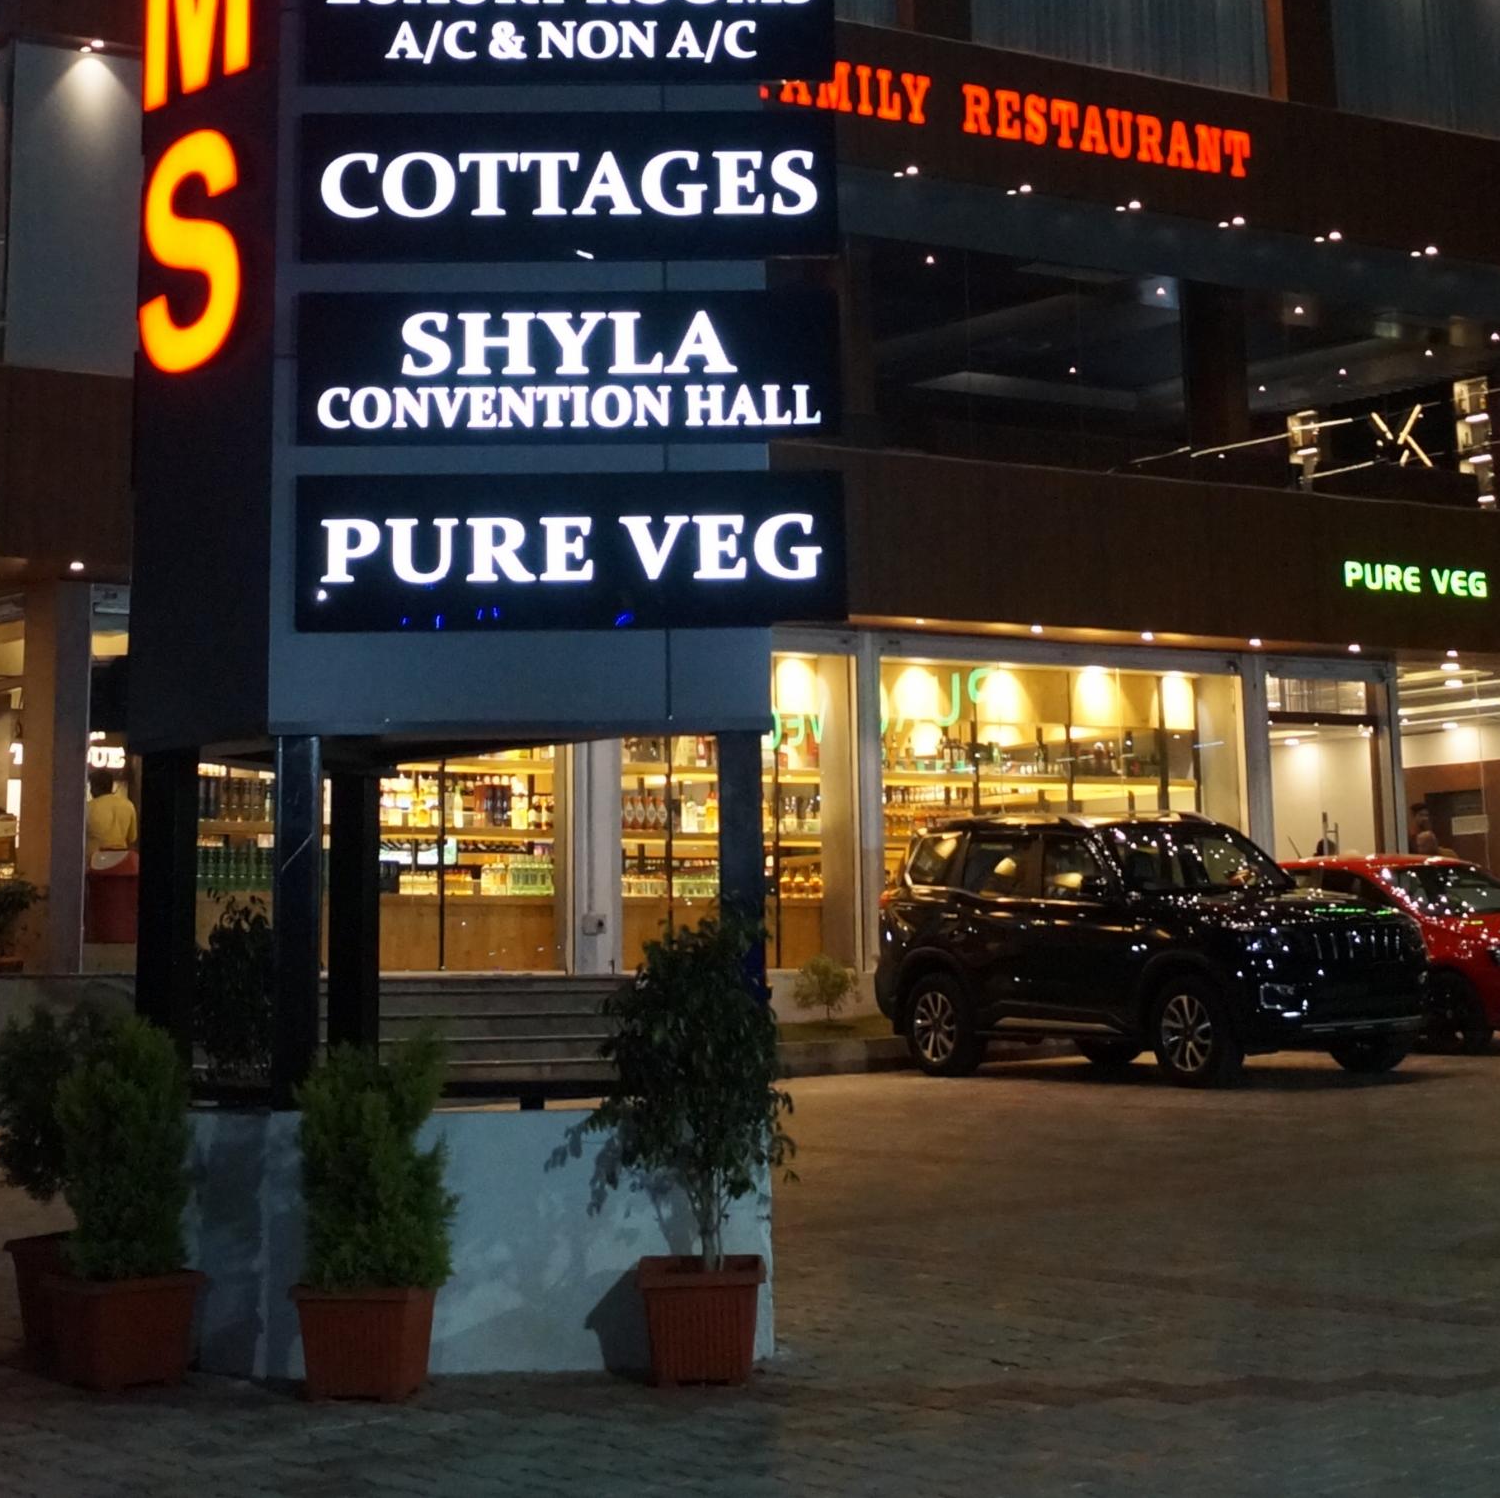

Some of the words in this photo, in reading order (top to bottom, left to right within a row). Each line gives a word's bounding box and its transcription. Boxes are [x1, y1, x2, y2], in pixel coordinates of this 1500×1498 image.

[385, 20, 477, 64] A/C
[488, 20, 527, 60] &
[538, 20, 658, 60] NON
[666, 20, 757, 63] A/C
[760, 61, 931, 125] AMILY
[962, 84, 1251, 178] RESTAURANT
[320, 149, 818, 219] COTTAGES
[401, 310, 738, 377] SHYLA
[317, 384, 672, 429] CONVENTION
[684, 384, 821, 427] HALL
[320, 516, 594, 584] PURE
[618, 512, 823, 580] VEG
[1344, 561, 1421, 593] PURE
[1431, 568, 1488, 598] VEG
